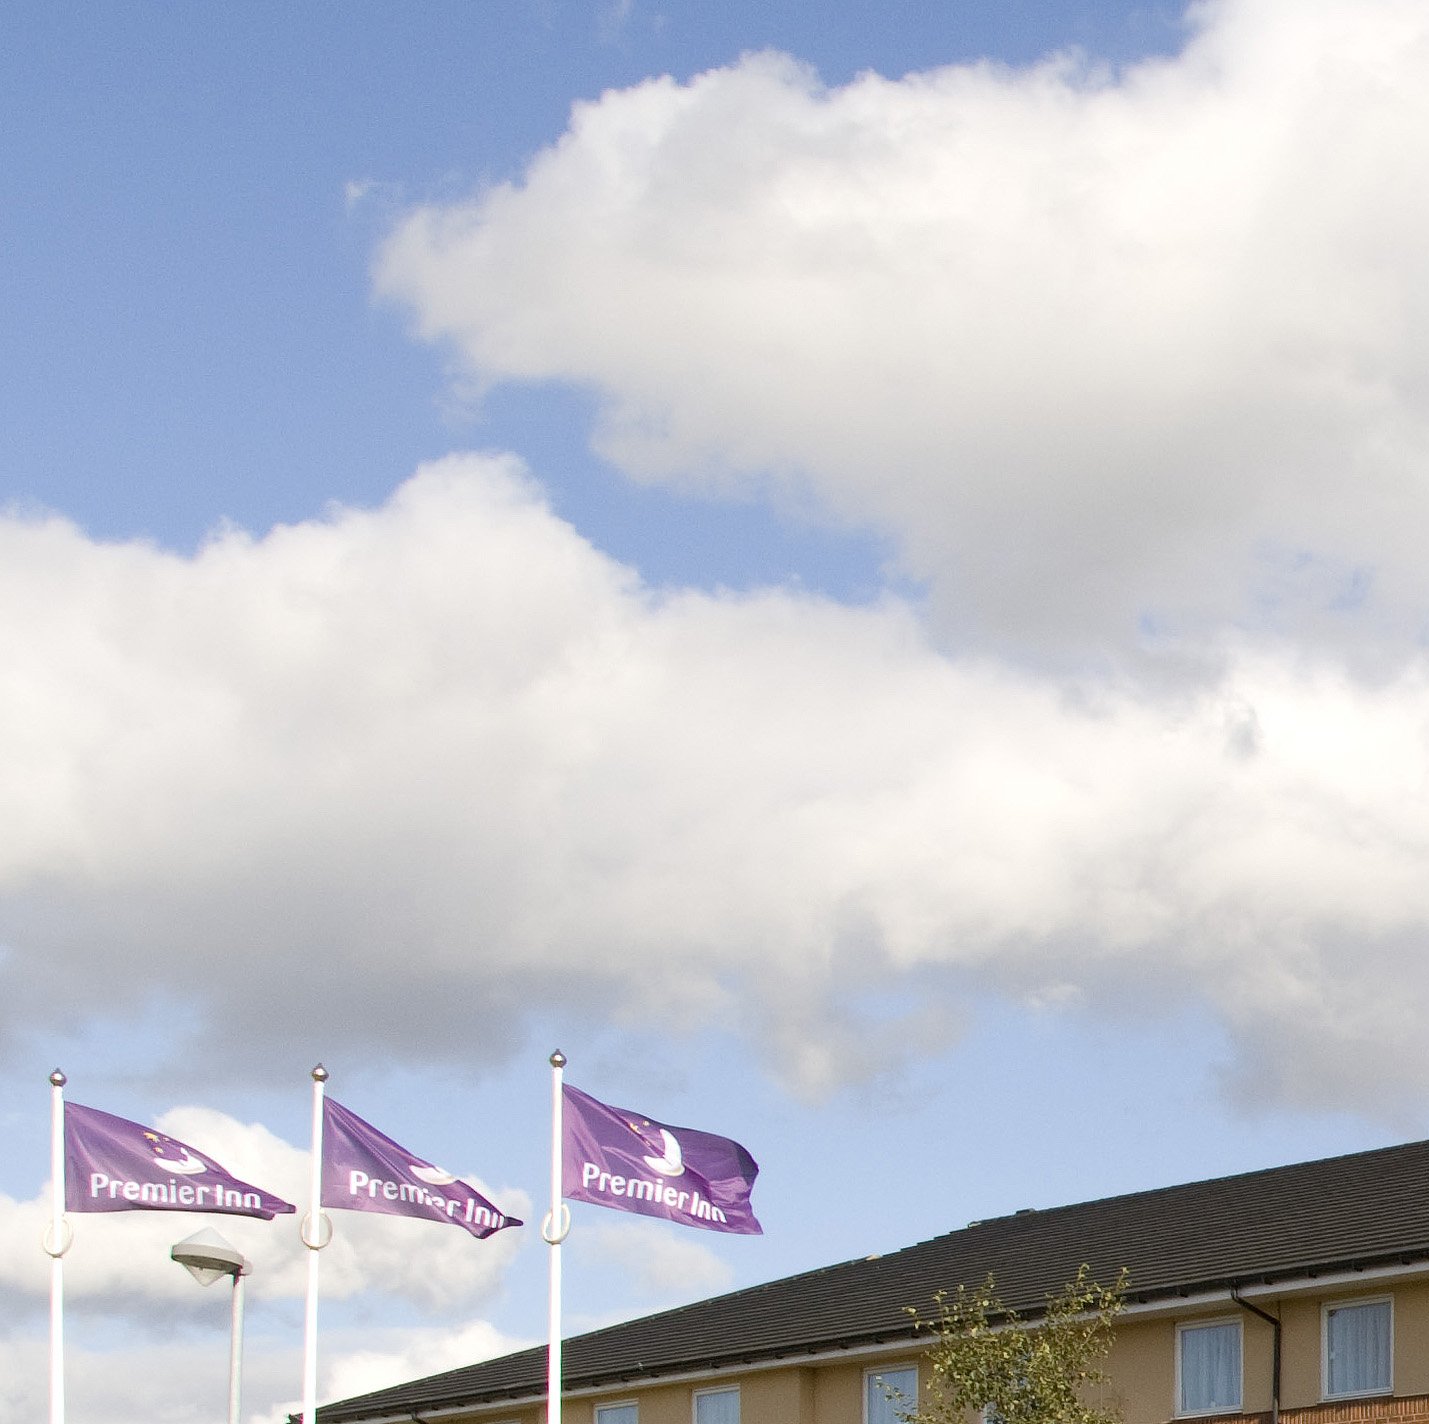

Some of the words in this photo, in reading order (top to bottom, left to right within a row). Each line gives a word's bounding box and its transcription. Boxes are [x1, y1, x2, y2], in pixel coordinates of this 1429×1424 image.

[90, 1173, 209, 1205] Premier
[216, 1184, 262, 1209] Inn
[583, 1162, 690, 1210] Premier
[690, 1191, 728, 1224] Inn
